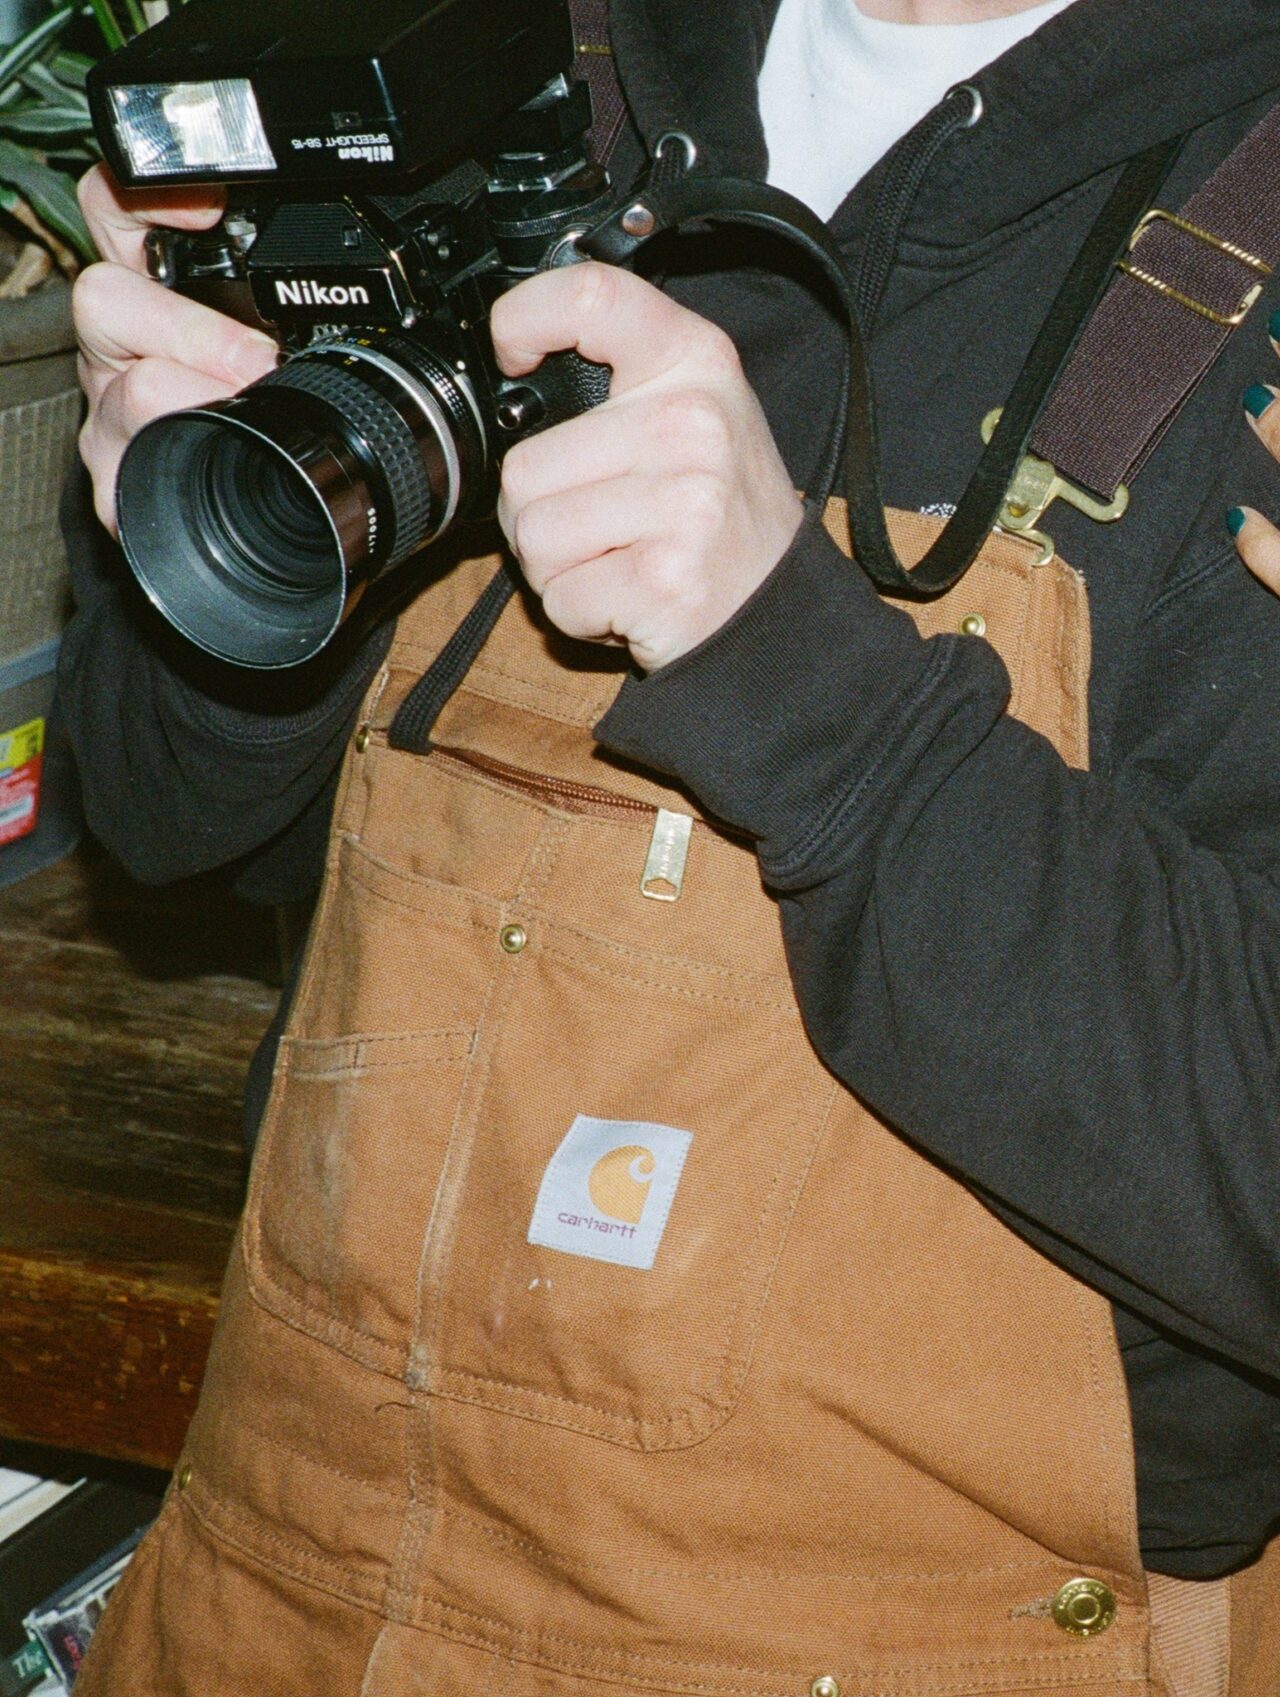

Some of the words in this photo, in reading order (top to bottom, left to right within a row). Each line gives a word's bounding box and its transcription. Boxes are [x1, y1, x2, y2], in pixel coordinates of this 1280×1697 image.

[291, 137, 322, 150] SB-15
[325, 132, 390, 148] SPEEDLIGHT
[338, 145, 395, 163] Nikon
[275, 280, 370, 305] Nikon
[558, 1212, 637, 1239] carhartt
